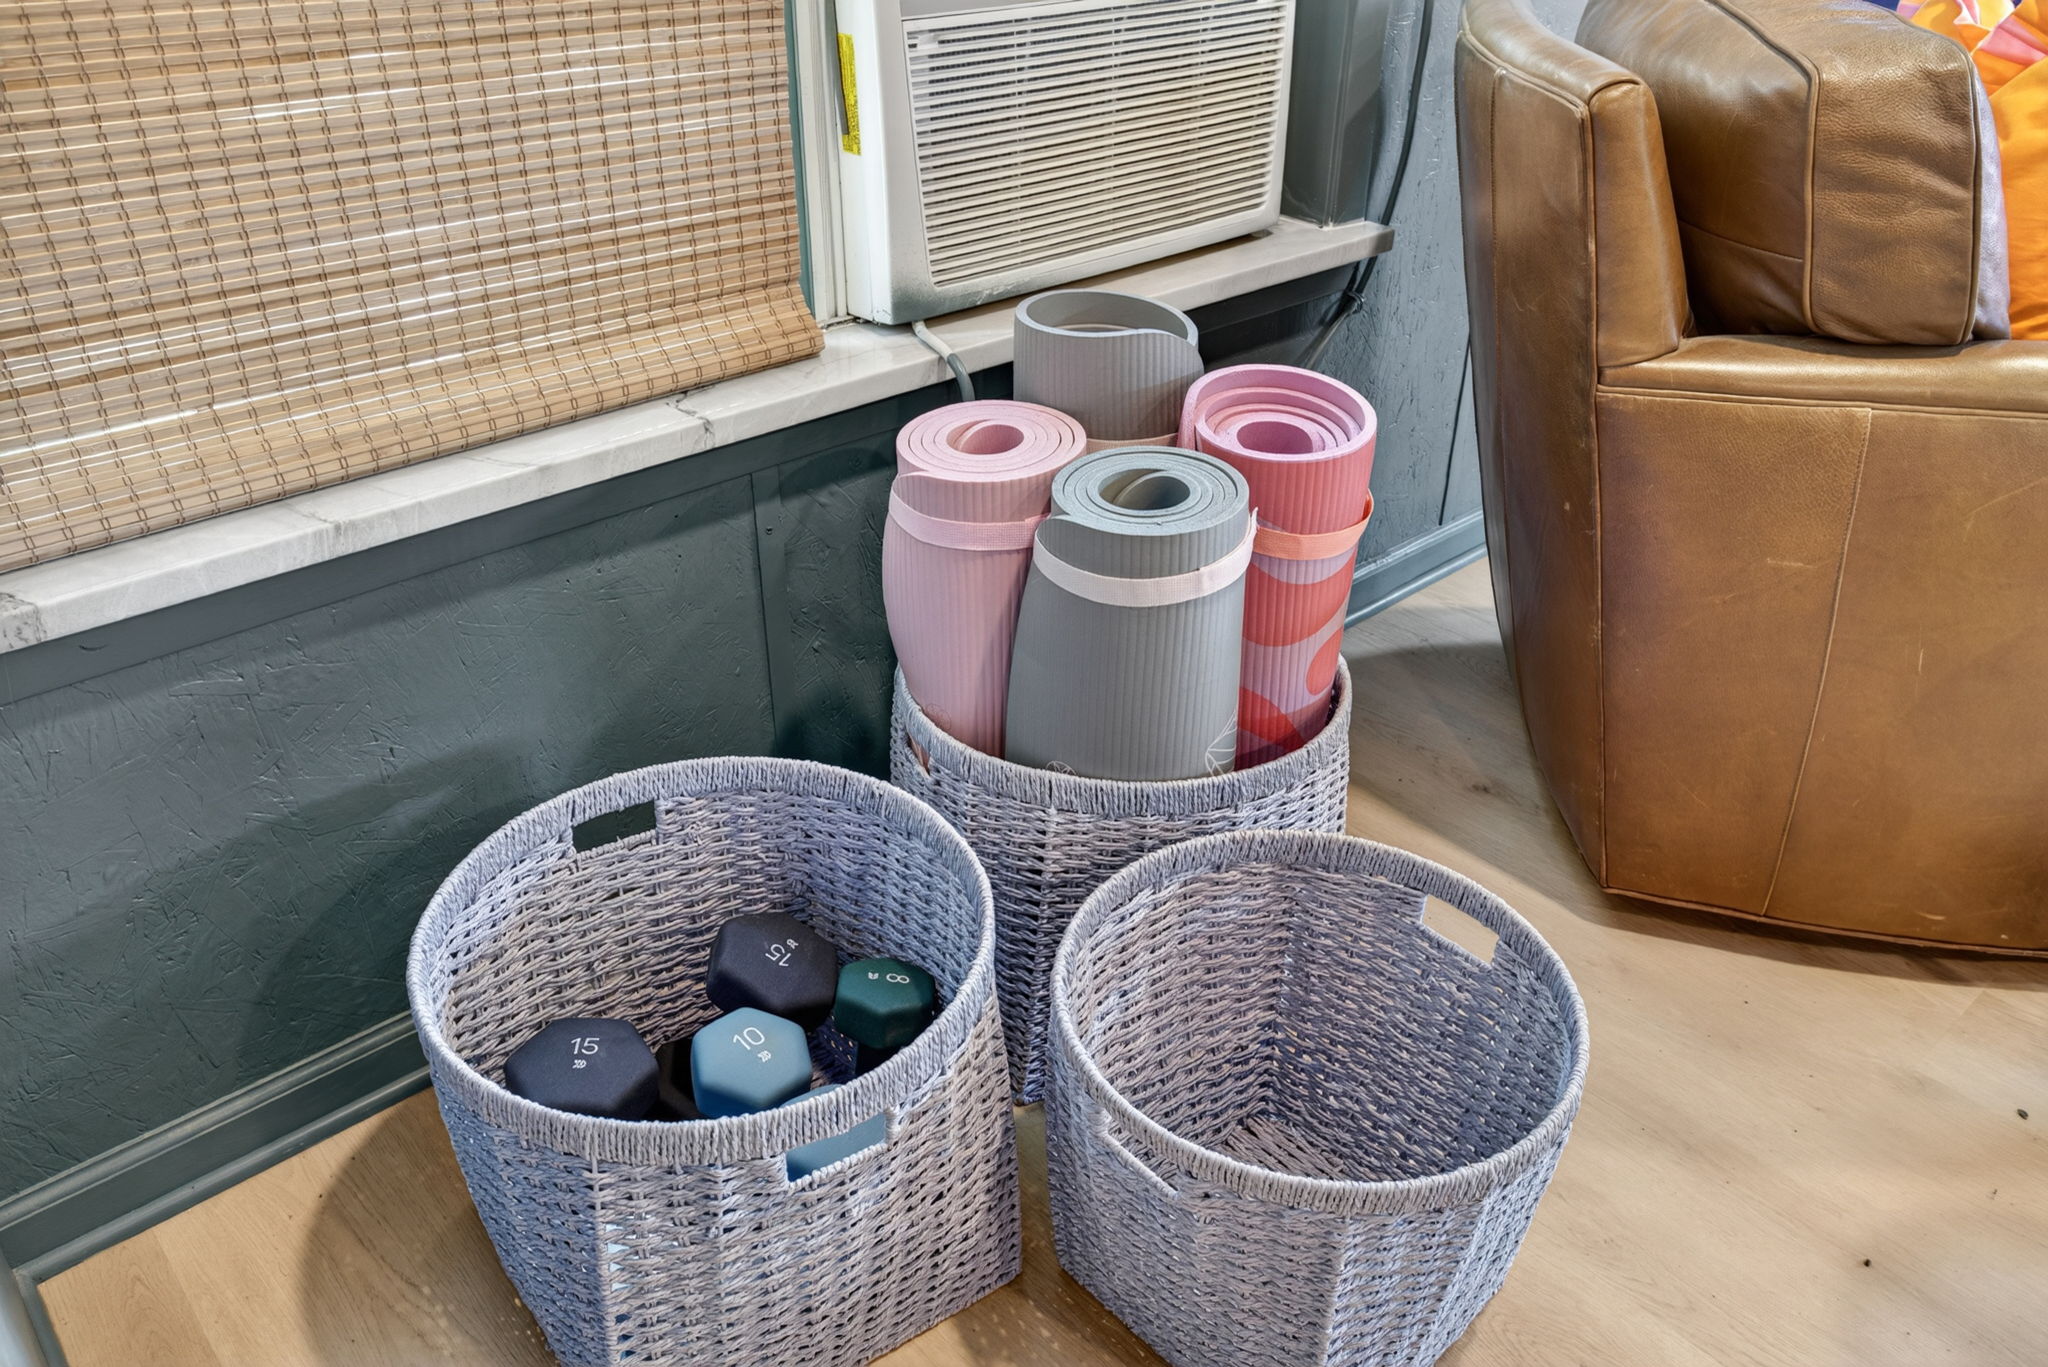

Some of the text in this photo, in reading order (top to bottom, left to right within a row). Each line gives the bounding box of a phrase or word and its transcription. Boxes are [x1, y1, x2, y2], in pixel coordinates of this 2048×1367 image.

[765, 944, 791, 967] 15
[886, 973, 910, 984] 8
[571, 1037, 600, 1055] 15
[733, 1027, 765, 1050] 10
